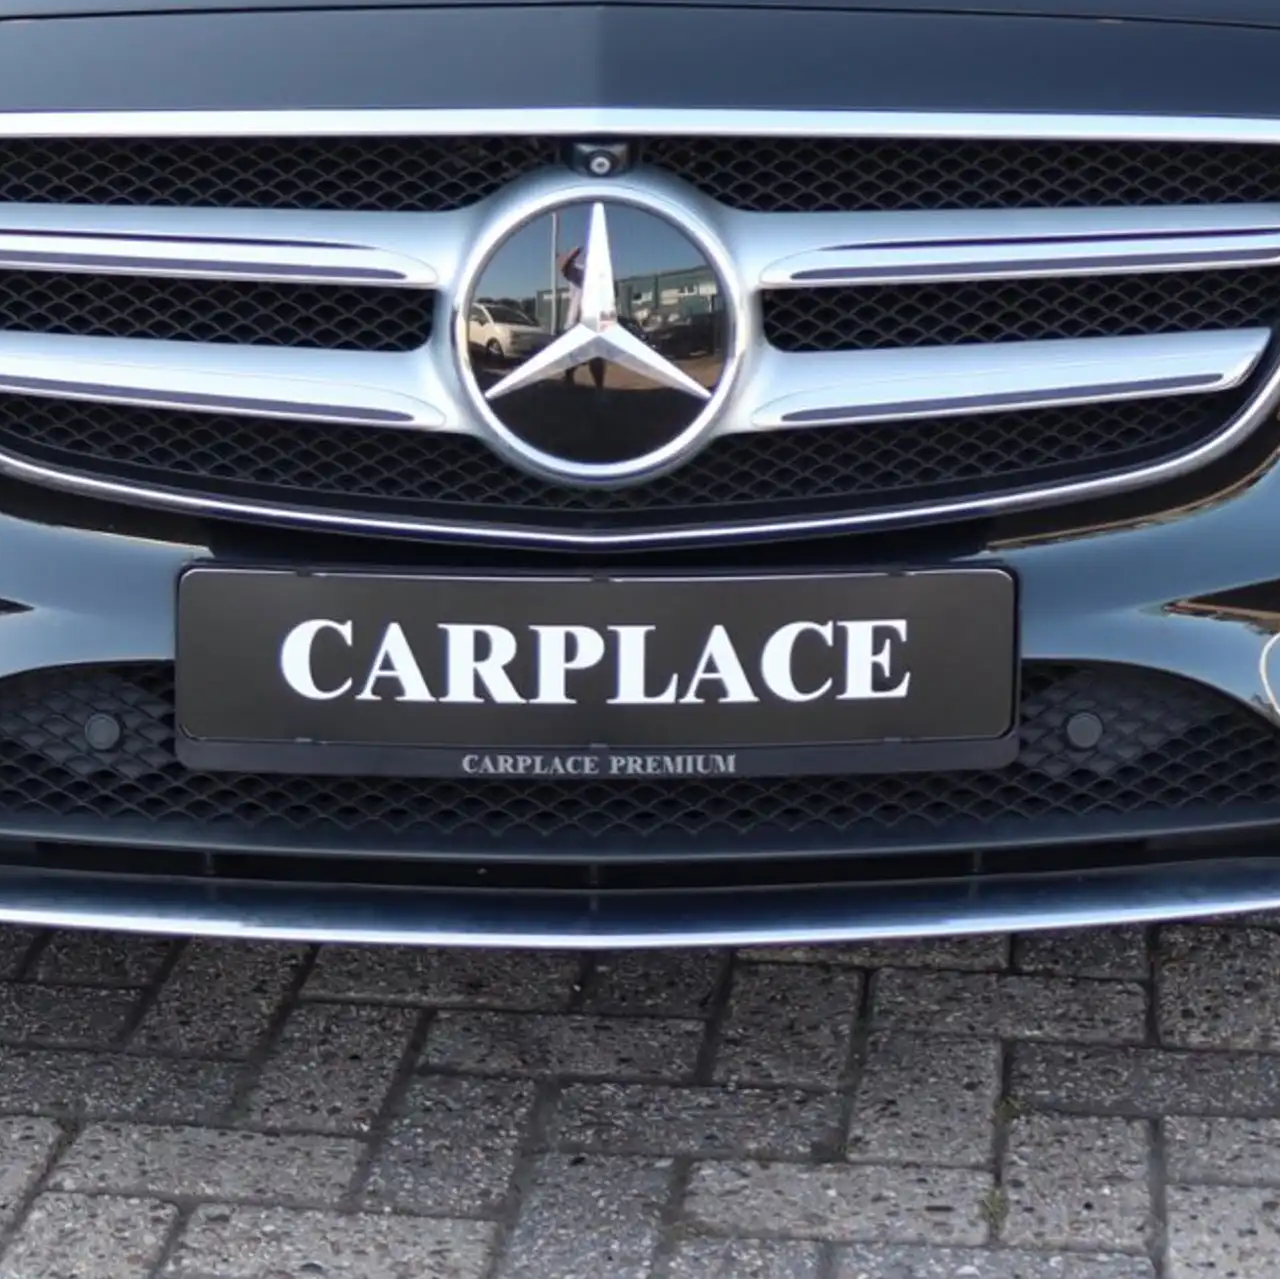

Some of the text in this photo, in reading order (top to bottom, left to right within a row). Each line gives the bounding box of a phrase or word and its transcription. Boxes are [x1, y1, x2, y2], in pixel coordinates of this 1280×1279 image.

[280, 618, 912, 704] CARPLACE
[461, 754, 737, 776] CARPLACE PREMIUM
